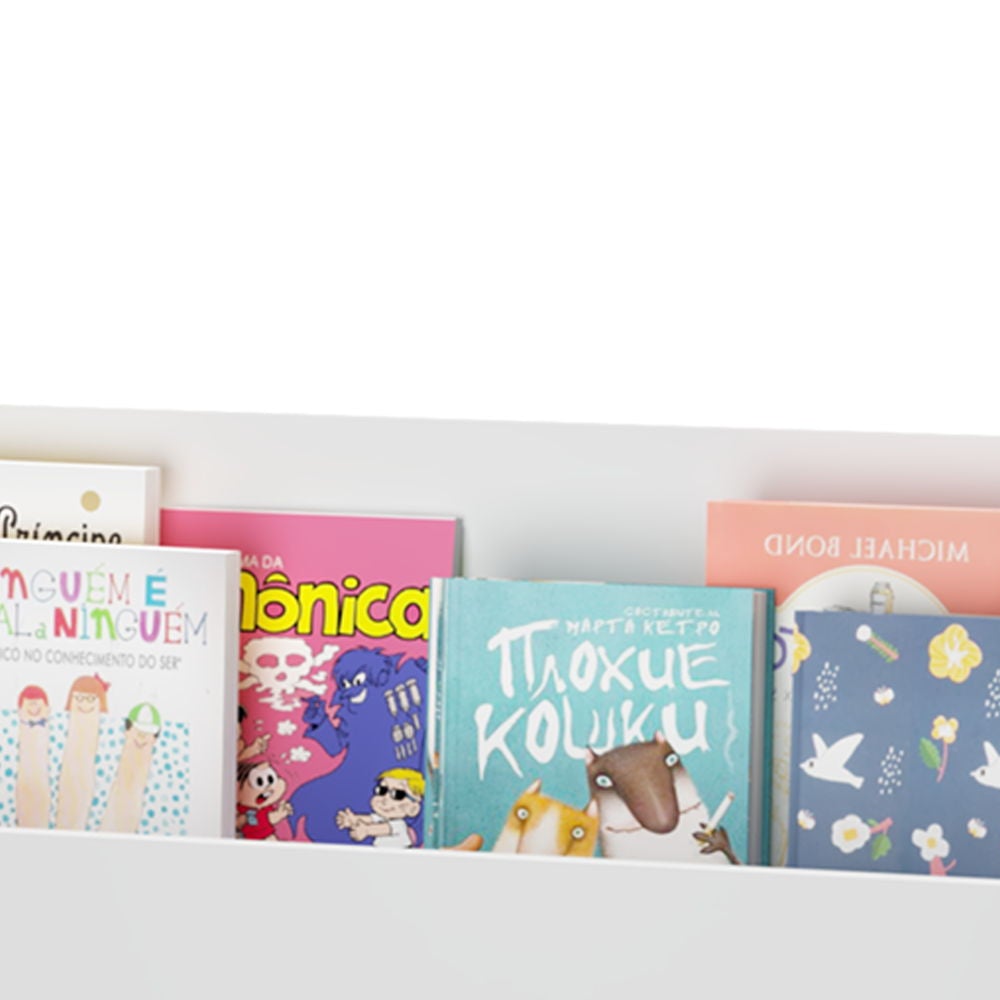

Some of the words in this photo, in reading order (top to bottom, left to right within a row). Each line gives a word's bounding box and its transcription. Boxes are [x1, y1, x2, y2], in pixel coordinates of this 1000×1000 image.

[262, 554, 284, 569] DA
[145, 568, 168, 607] É
[643, 618, 720, 636] КЕТРО
[23, 648, 42, 663] NO
[45, 648, 136, 669] CONHECIMENTO
[138, 654, 157, 669] DO
